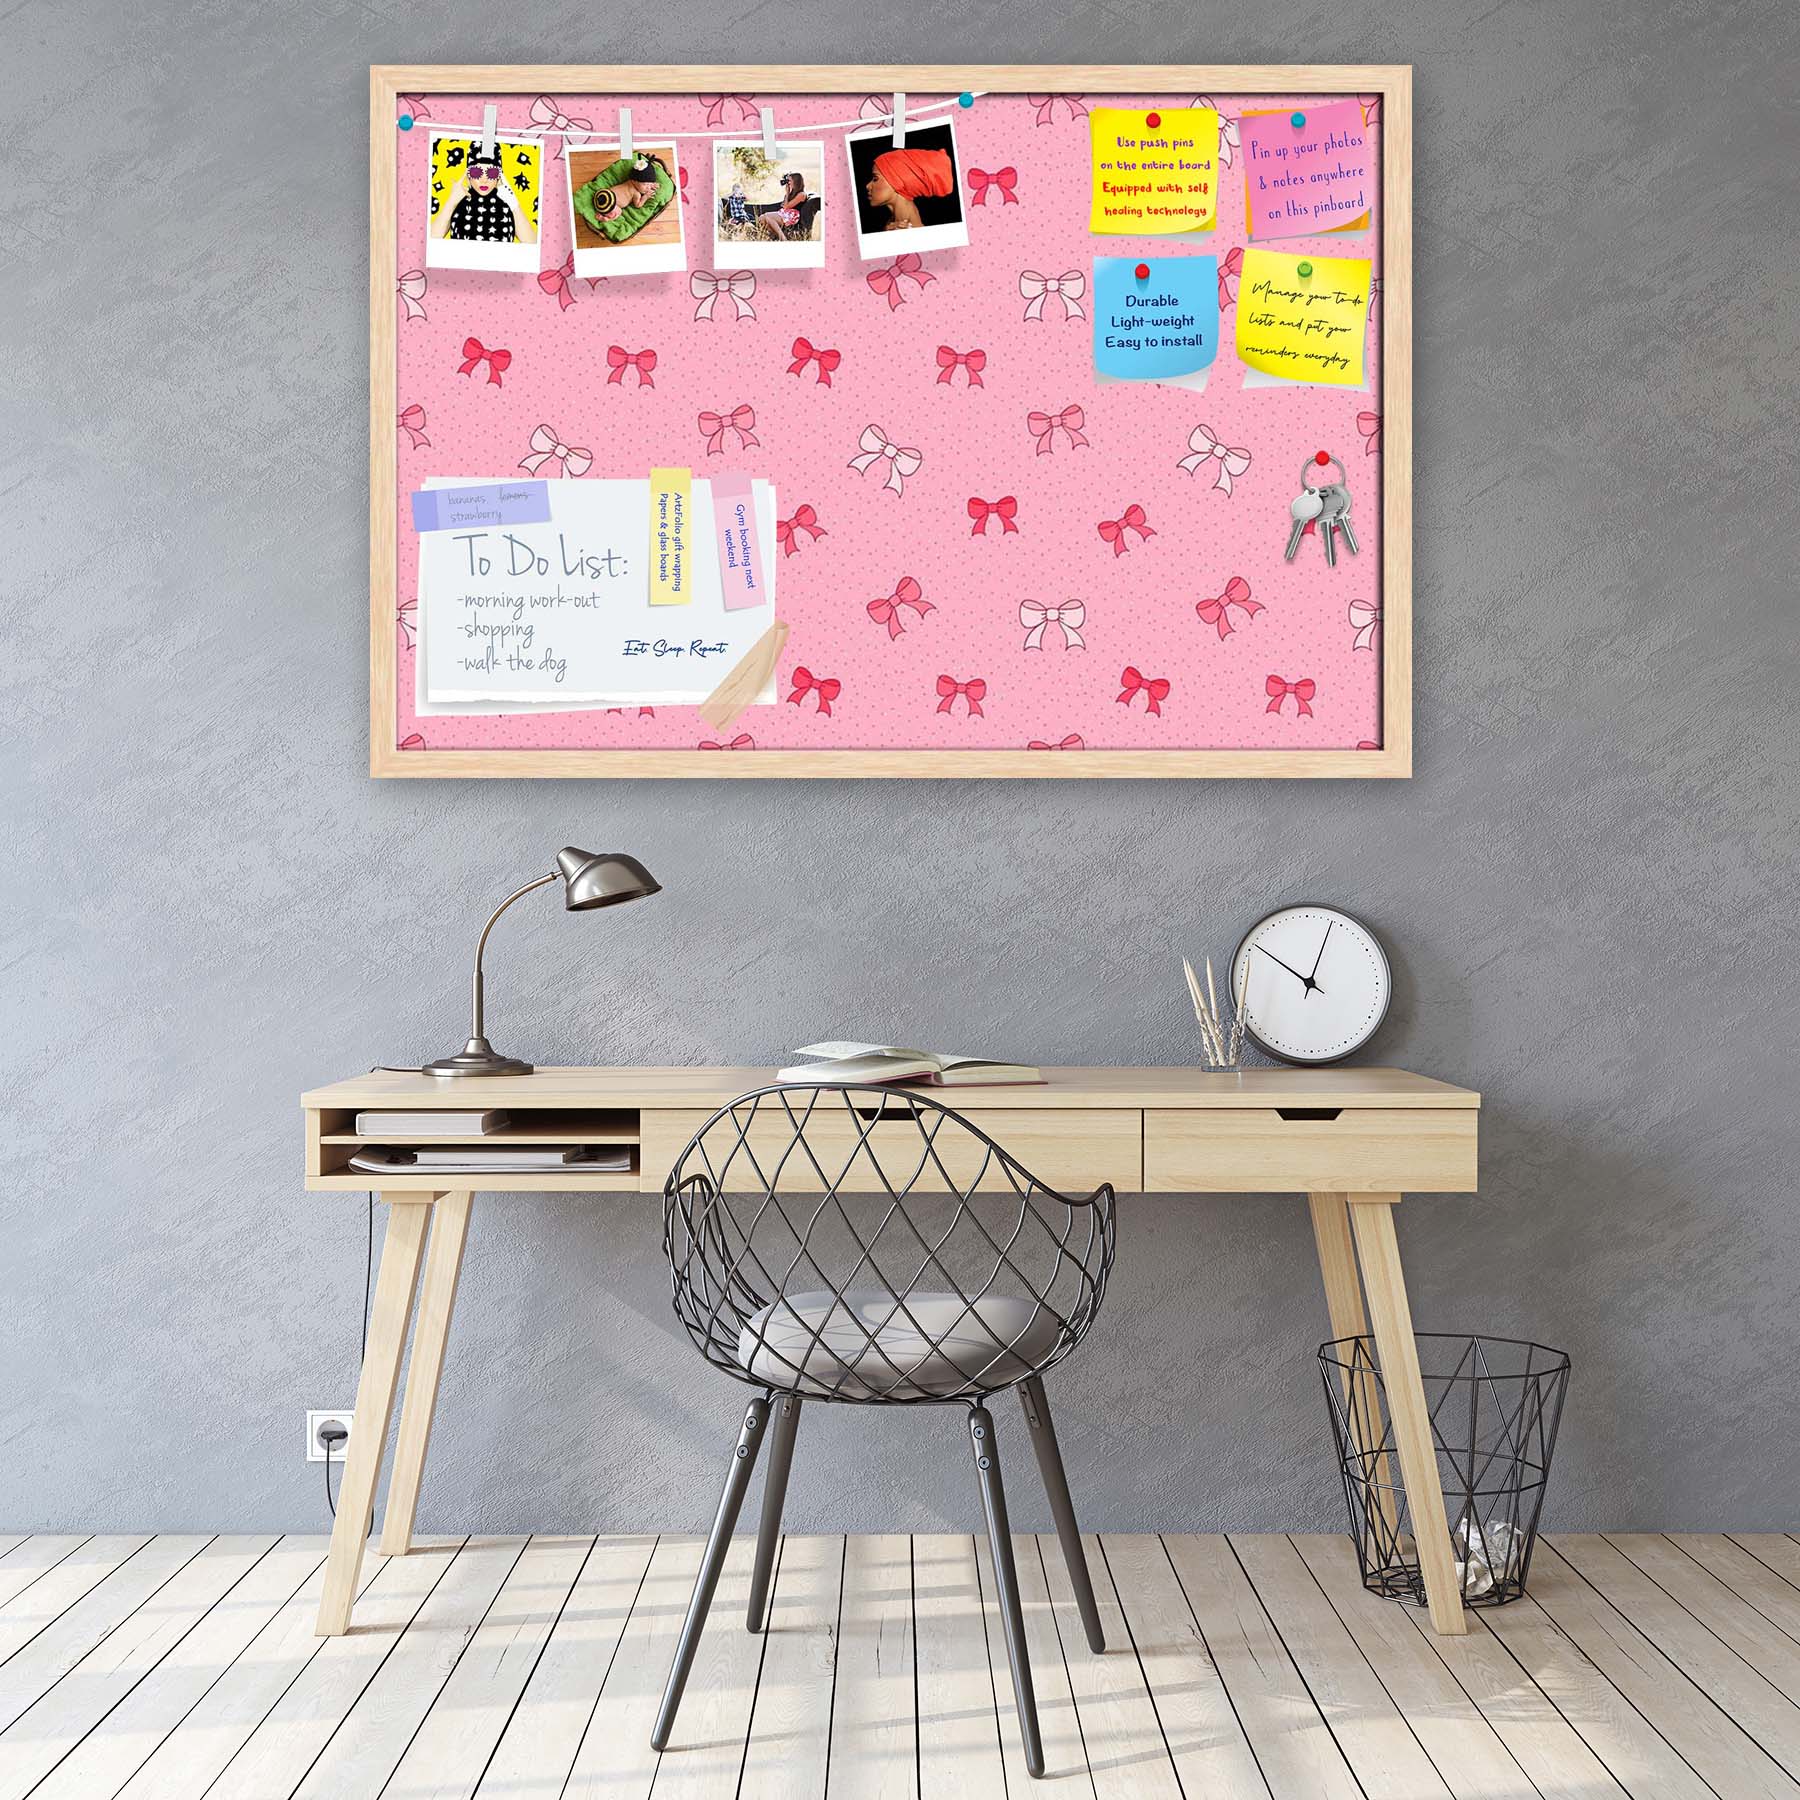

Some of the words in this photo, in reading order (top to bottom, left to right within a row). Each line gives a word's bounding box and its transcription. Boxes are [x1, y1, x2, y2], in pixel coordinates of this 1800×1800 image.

[1117, 136, 1135, 147] Use
[1140, 138, 1168, 151] push
[1173, 138, 1194, 151] pins
[1252, 140, 1270, 160] Pin
[1276, 148, 1288, 160] up
[1294, 144, 1318, 159] your
[1324, 131, 1362, 155] photos
[1100, 162, 1112, 170] on
[1117, 161, 1136, 170] the
[1142, 161, 1174, 170] entire
[1179, 160, 1210, 170] board
[1259, 175, 1267, 190] &
[1273, 170, 1305, 188] notes
[1310, 162, 1364, 186] anywhere
[1102, 182, 1152, 196] Equipped
[1157, 184, 1182, 194] with
[1188, 183, 1208, 194] self
[1104, 206, 1142, 218] healing
[1146, 206, 1206, 218] technology
[1268, 210, 1281, 220] on
[1286, 200, 1308, 216] this
[1314, 190, 1364, 218] pinboard
[1126, 294, 1179, 307] Durable
[1252, 280, 1304, 304] Manage
[1112, 314, 1194, 330] Light-weight
[1280, 318, 1304, 330] and
[1304, 320, 1328, 336] put
[1326, 326, 1352, 338] your
[1105, 336, 1141, 350] Easy
[1144, 336, 1158, 347] to
[1161, 334, 1203, 346] install
[1246, 346, 1300, 358] reminders
[1304, 352, 1350, 370] everyday
[450, 505, 502, 522] strawberry
[658, 493, 668, 520] Papers
[734, 504, 746, 526] Gym
[660, 522, 668, 530] &
[658, 531, 670, 552] glass
[672, 536, 684, 551] gift
[724, 528, 739, 568] weekend
[740, 528, 752, 567] booking
[452, 533, 491, 576] To
[502, 533, 549, 576] Do
[559, 533, 628, 580] List:
[660, 553, 670, 582] boards
[672, 553, 681, 592] wrapping
[745, 568, 756, 590] next
[530, 584, 601, 609] work-out
[506, 644, 536, 672] the
[538, 648, 568, 684] dog
